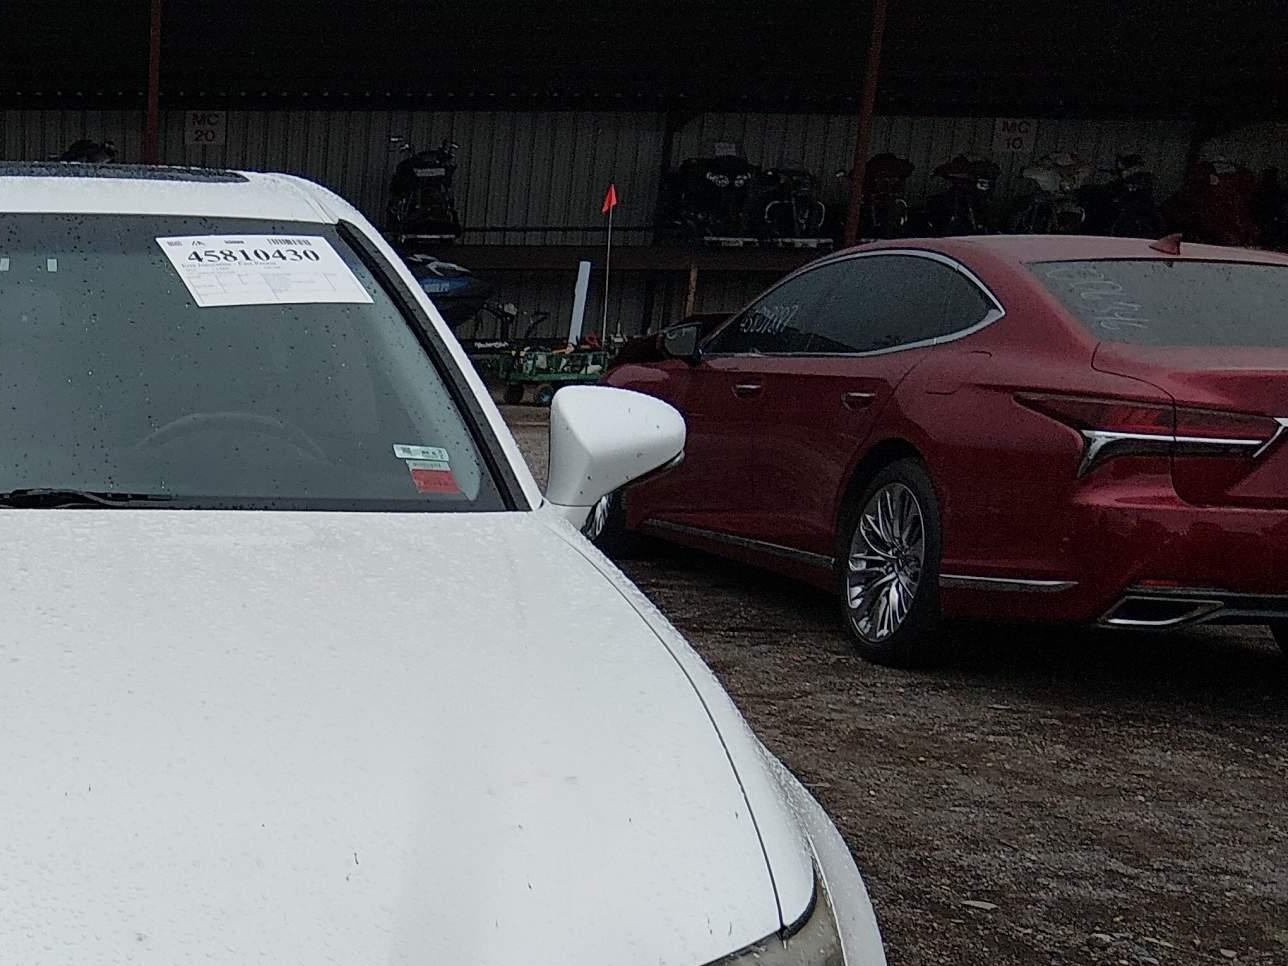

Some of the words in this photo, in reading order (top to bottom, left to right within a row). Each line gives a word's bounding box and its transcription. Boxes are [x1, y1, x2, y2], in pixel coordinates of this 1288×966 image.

[191, 112, 220, 126] MC
[193, 129, 216, 142] 20
[1004, 137, 1023, 149] 10
[187, 249, 320, 263] 45810430
